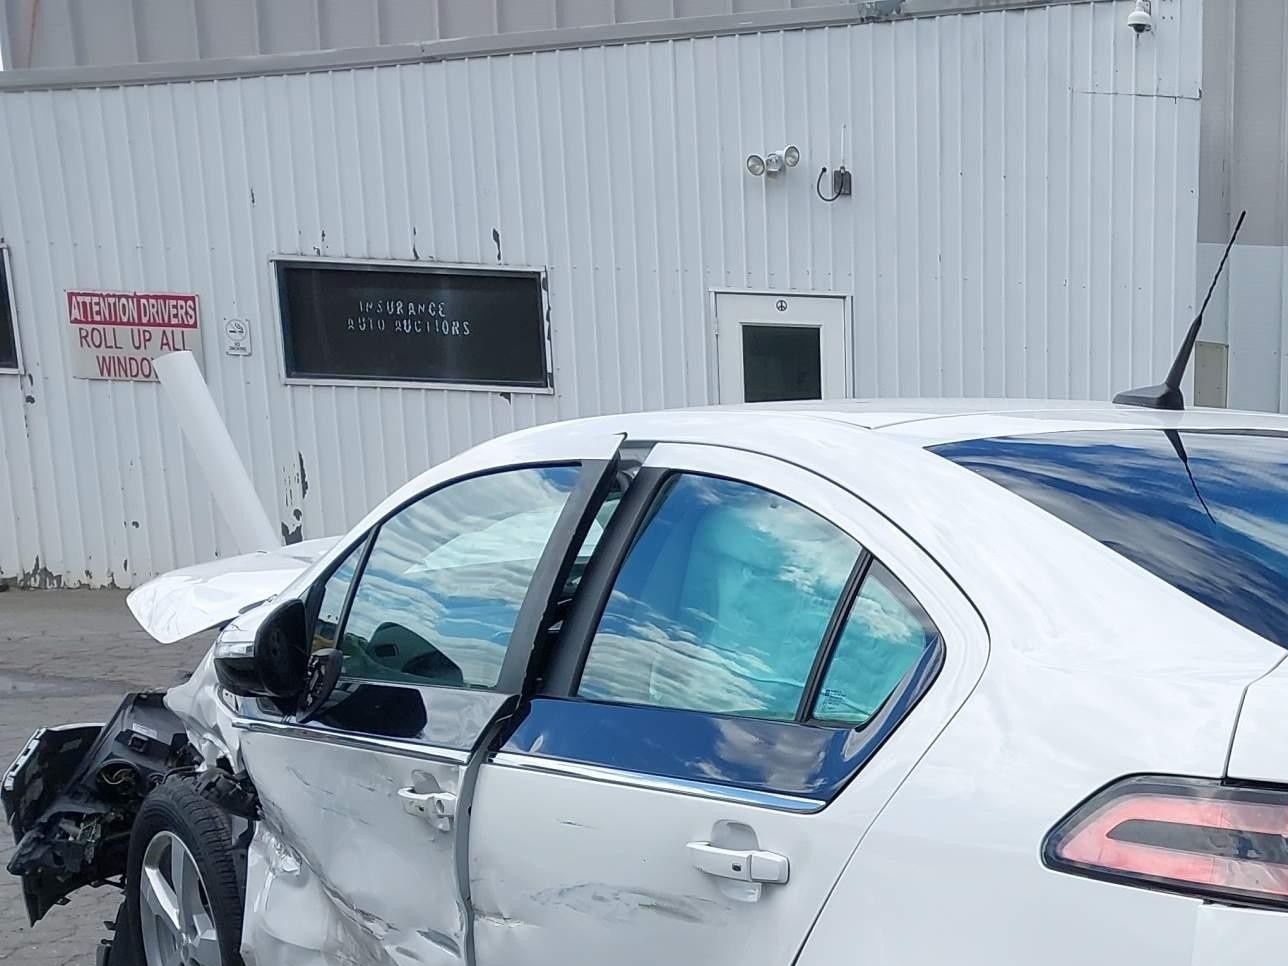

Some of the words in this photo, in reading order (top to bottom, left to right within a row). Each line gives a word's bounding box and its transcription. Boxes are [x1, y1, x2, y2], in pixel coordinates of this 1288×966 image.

[70, 295, 138, 324] ATTENTION
[140, 298, 196, 326] DRIVERS
[359, 300, 447, 317] INSURANCE
[347, 317, 386, 331] AUTO
[78, 327, 124, 350] ROLL
[130, 328, 153, 351] UP
[159, 329, 193, 352] ALL
